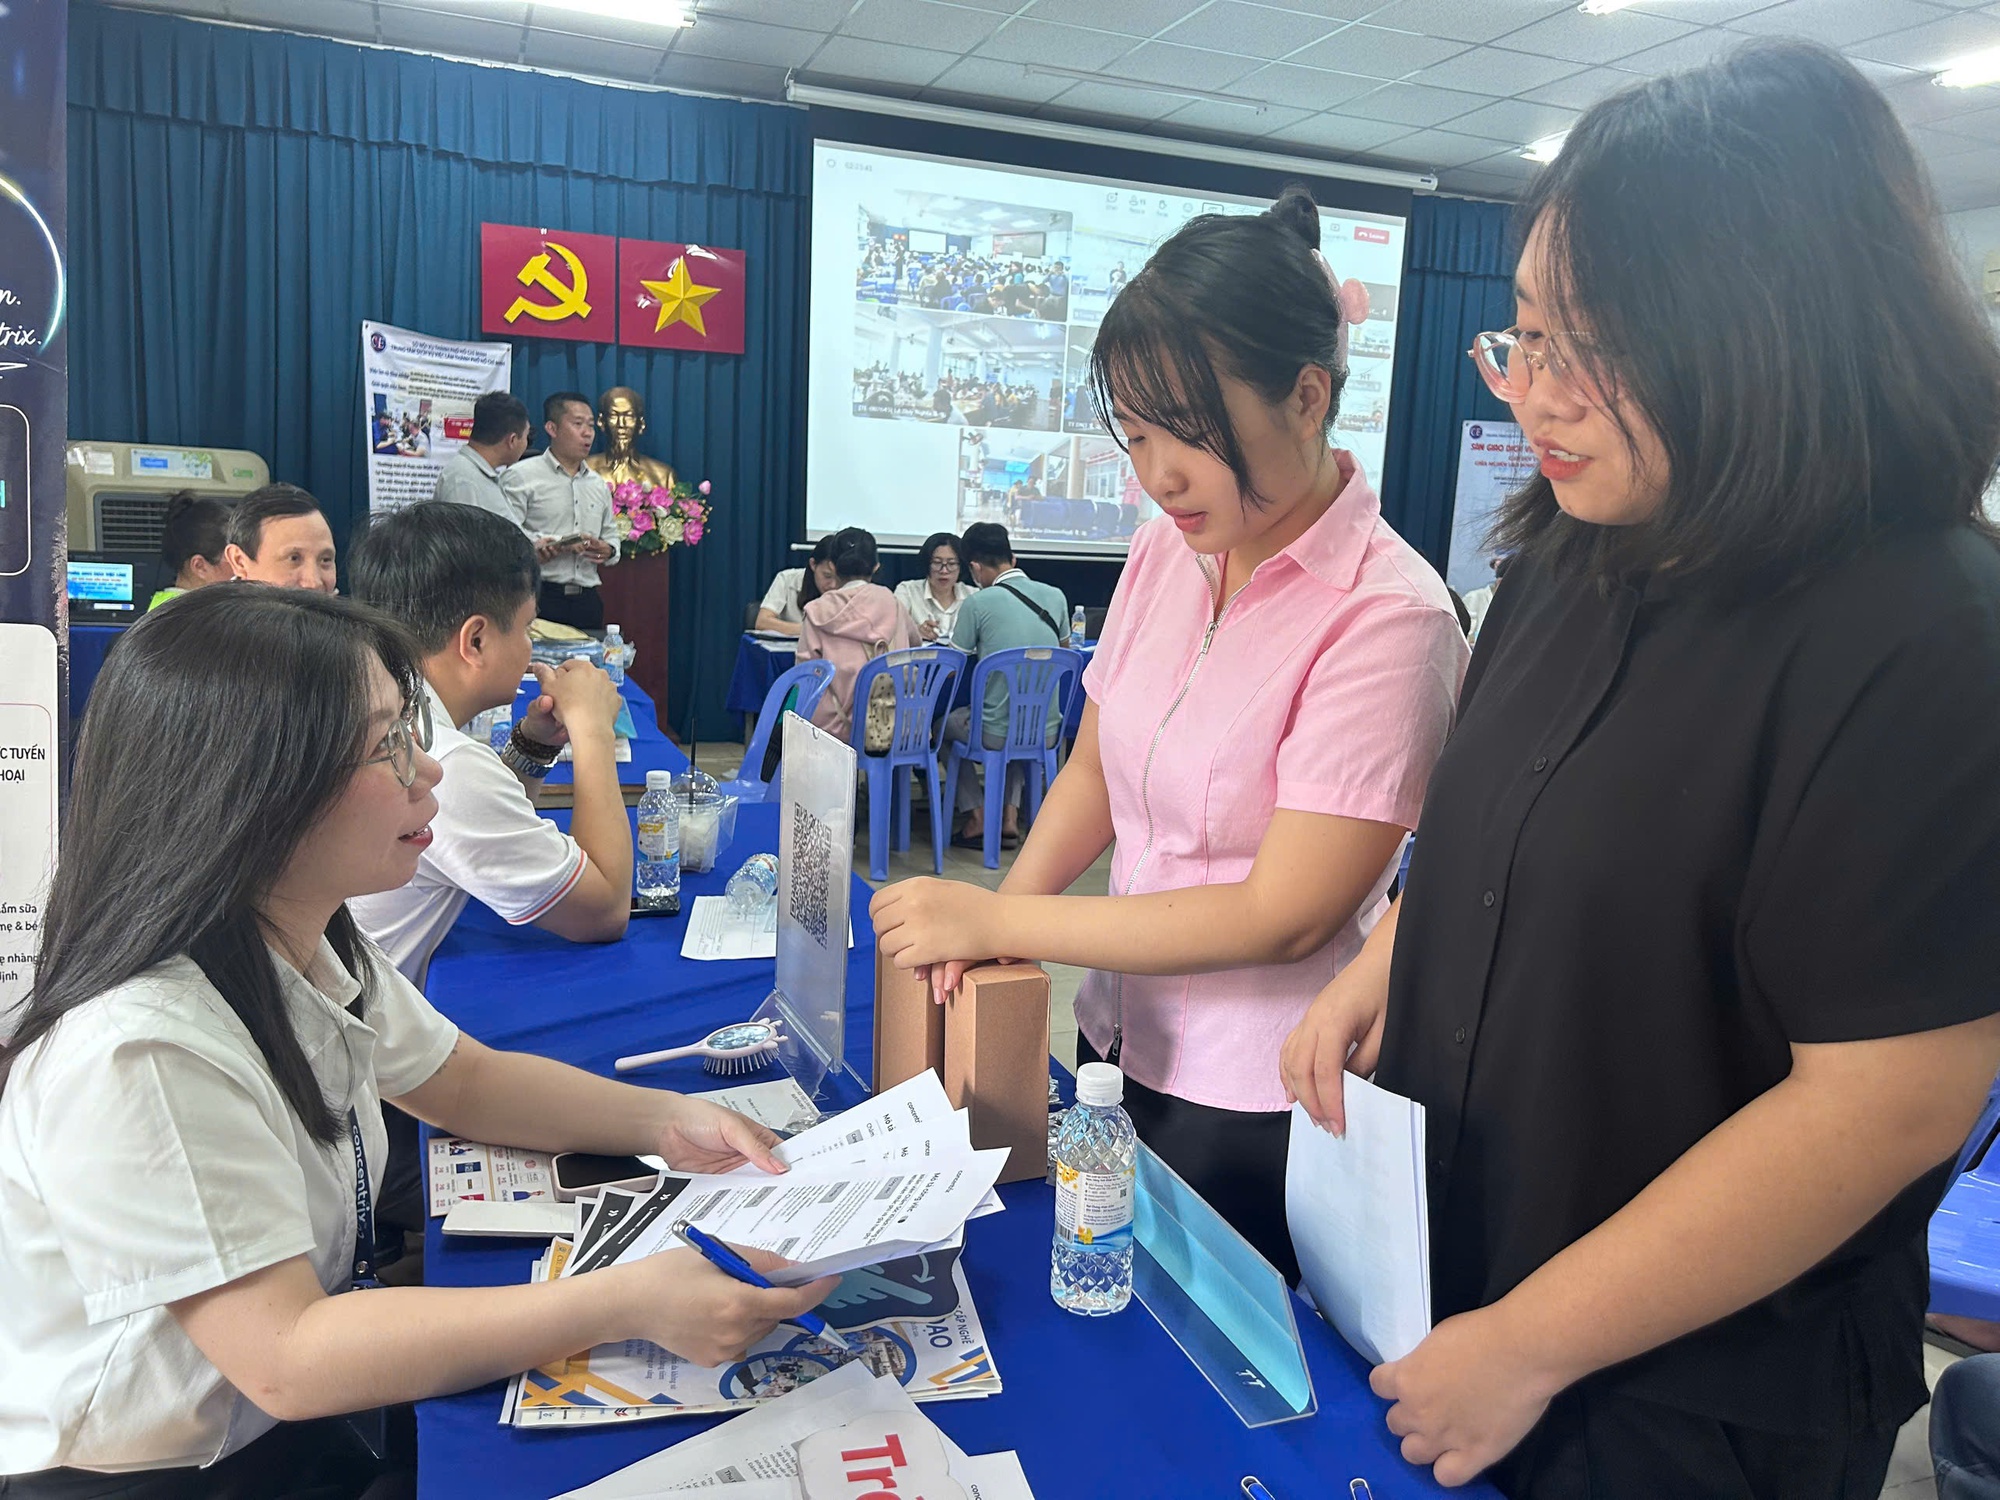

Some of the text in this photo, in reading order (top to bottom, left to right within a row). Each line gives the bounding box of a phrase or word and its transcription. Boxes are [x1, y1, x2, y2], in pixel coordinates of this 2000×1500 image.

[9, 743, 46, 760] TUYẾN
[0, 902, 37, 914] ắm sữa
[15, 921, 23, 931] &
[907, 1101, 923, 1124] concentr
[957, 1324, 975, 1345] NGHỀ
